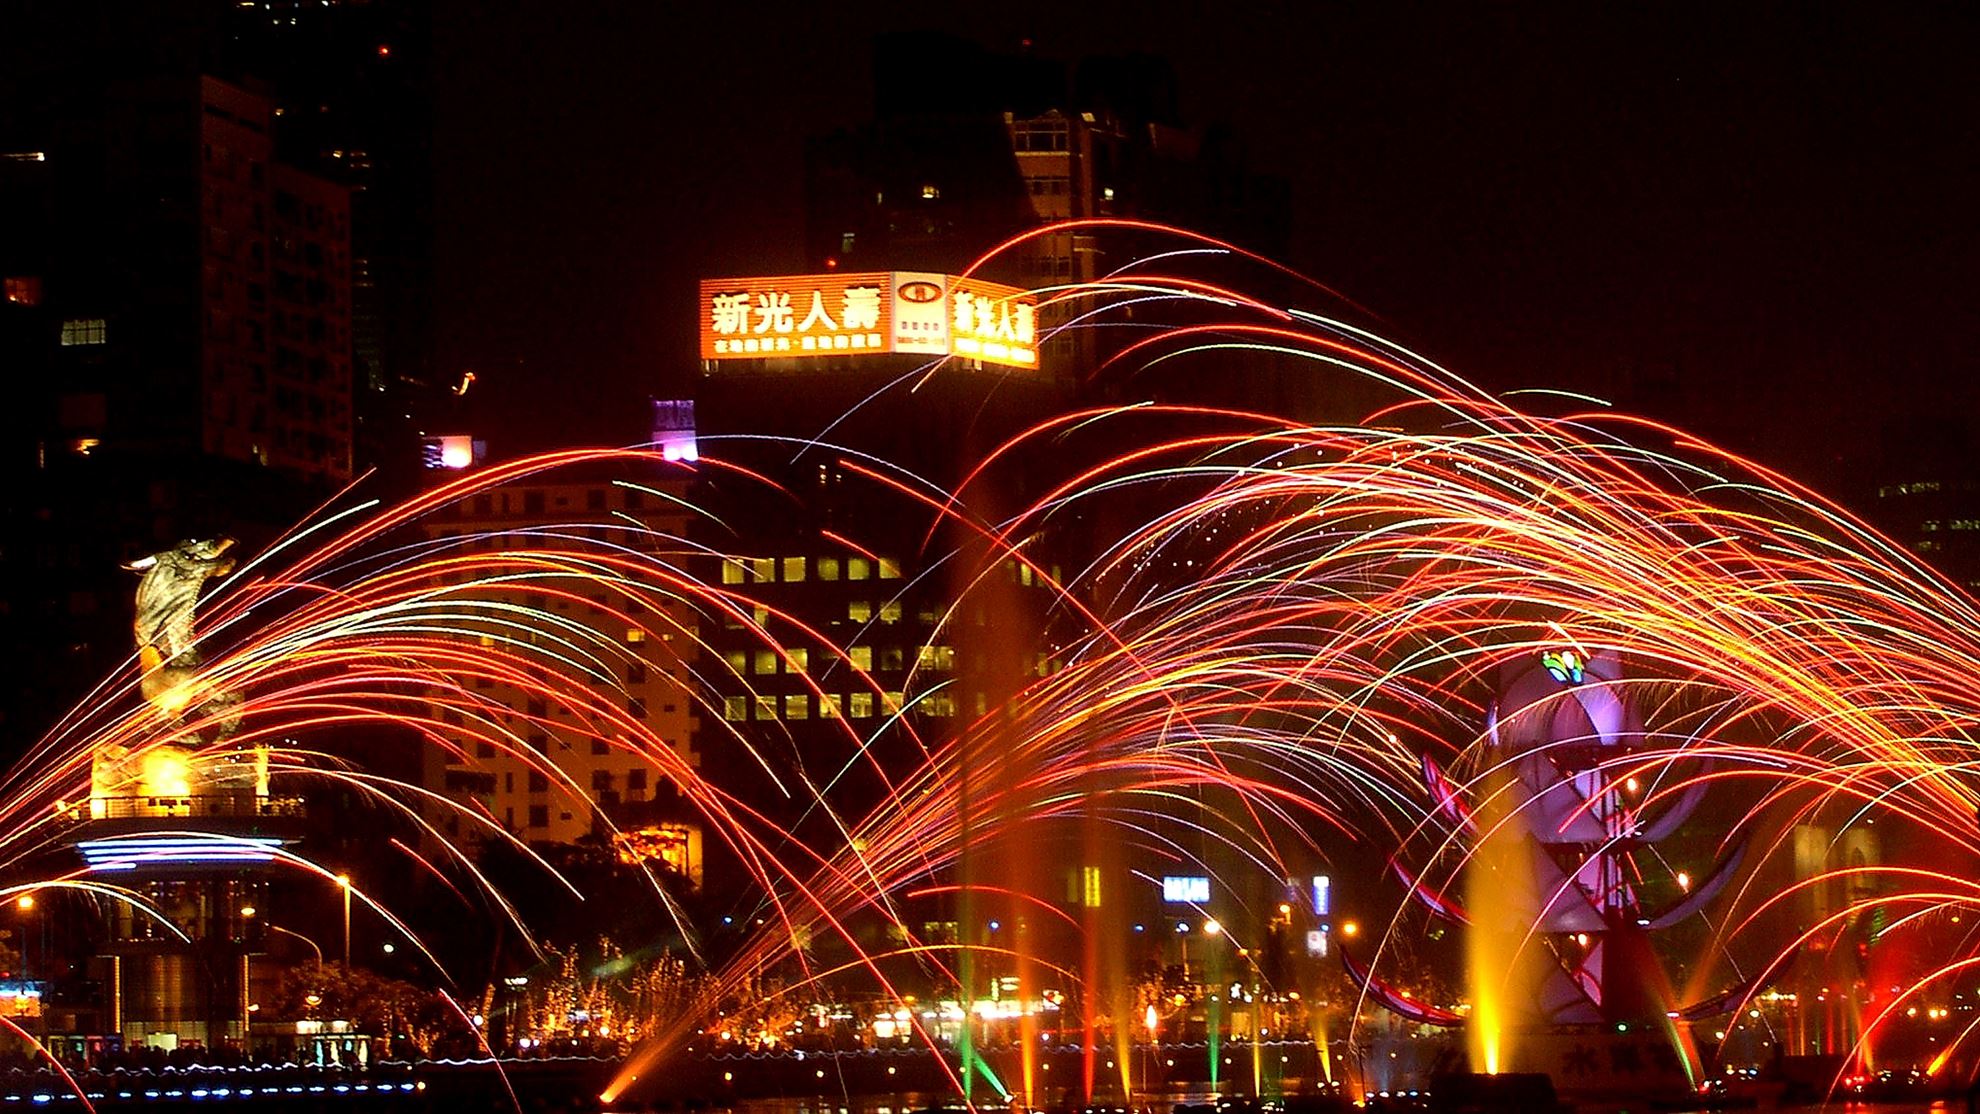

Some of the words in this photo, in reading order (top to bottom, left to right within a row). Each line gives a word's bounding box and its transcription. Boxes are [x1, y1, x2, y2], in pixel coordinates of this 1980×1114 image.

[711, 286, 881, 334] 新光人壽
[953, 290, 1035, 344] 新光人壽
